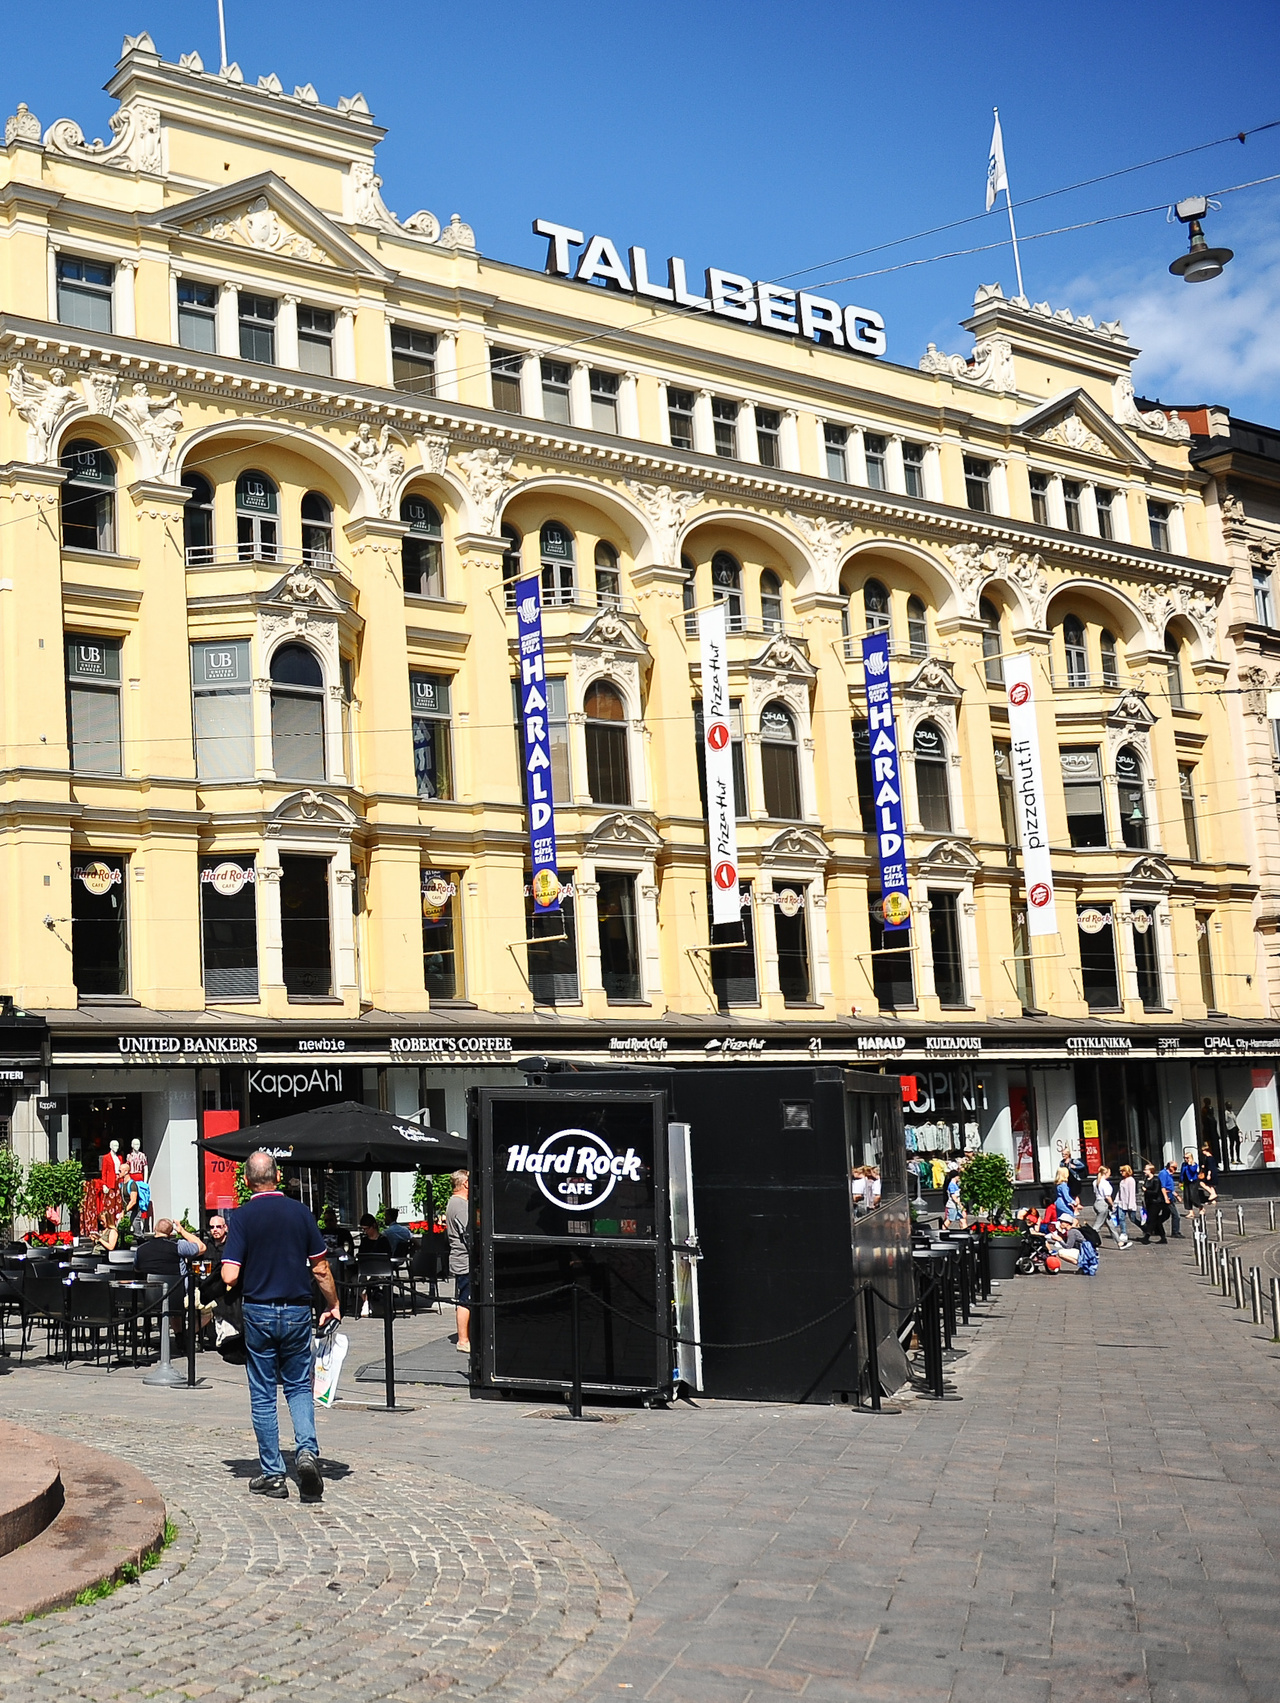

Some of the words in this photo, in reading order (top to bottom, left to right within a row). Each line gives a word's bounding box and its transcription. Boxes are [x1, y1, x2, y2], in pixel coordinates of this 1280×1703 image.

[532, 218, 887, 356] TALLBERG
[246, 481, 265, 496] UB
[80, 646, 101, 661] UB
[522, 643, 540, 655] TOLA
[709, 639, 721, 673] Hut
[209, 653, 232, 667] UB
[416, 683, 434, 697] UB
[710, 673, 724, 717] Pizza
[522, 654, 551, 830] HARALD
[1060, 755, 1093, 763] ORAL
[870, 703, 902, 858] HARALD
[716, 776, 728, 809] Hut
[1014, 740, 1045, 850] pizzahut.fi
[717, 811, 731, 856] Pizza
[74, 867, 98, 880] Hard
[98, 869, 122, 883] Rock
[201, 869, 229, 881] Hard
[230, 869, 256, 883] Rock
[437, 882, 457, 895] Rock
[1076, 915, 1091, 923] ard
[1092, 914, 1111, 924] Rock
[118, 1037, 181, 1053] UNITED
[184, 1037, 258, 1053] BANKERS
[298, 1038, 346, 1052] newbie
[391, 1037, 457, 1052] ROBERT'S
[458, 1037, 513, 1051] COFFEE
[610, 1037, 630, 1050] Hard
[630, 1037, 650, 1051] Rock
[650, 1038, 668, 1050] Cafe
[722, 1038, 748, 1050] Pizza
[748, 1038, 767, 1050] Hut
[809, 1037, 822, 1050] 21
[858, 1036, 906, 1050] HARALD
[926, 1037, 982, 1050] KULTAJOUSI
[1066, 1037, 1132, 1049] CITYKLINIKKA
[1158, 1037, 1180, 1048] ESPRIT
[1204, 1036, 1235, 1048] ORAL
[248, 1069, 343, 1097] KappAhl
[210, 1160, 235, 1173] 70%
[506, 1144, 575, 1174] Hard
[575, 1147, 642, 1182] Rock
[557, 1182, 593, 1196] CAFE
